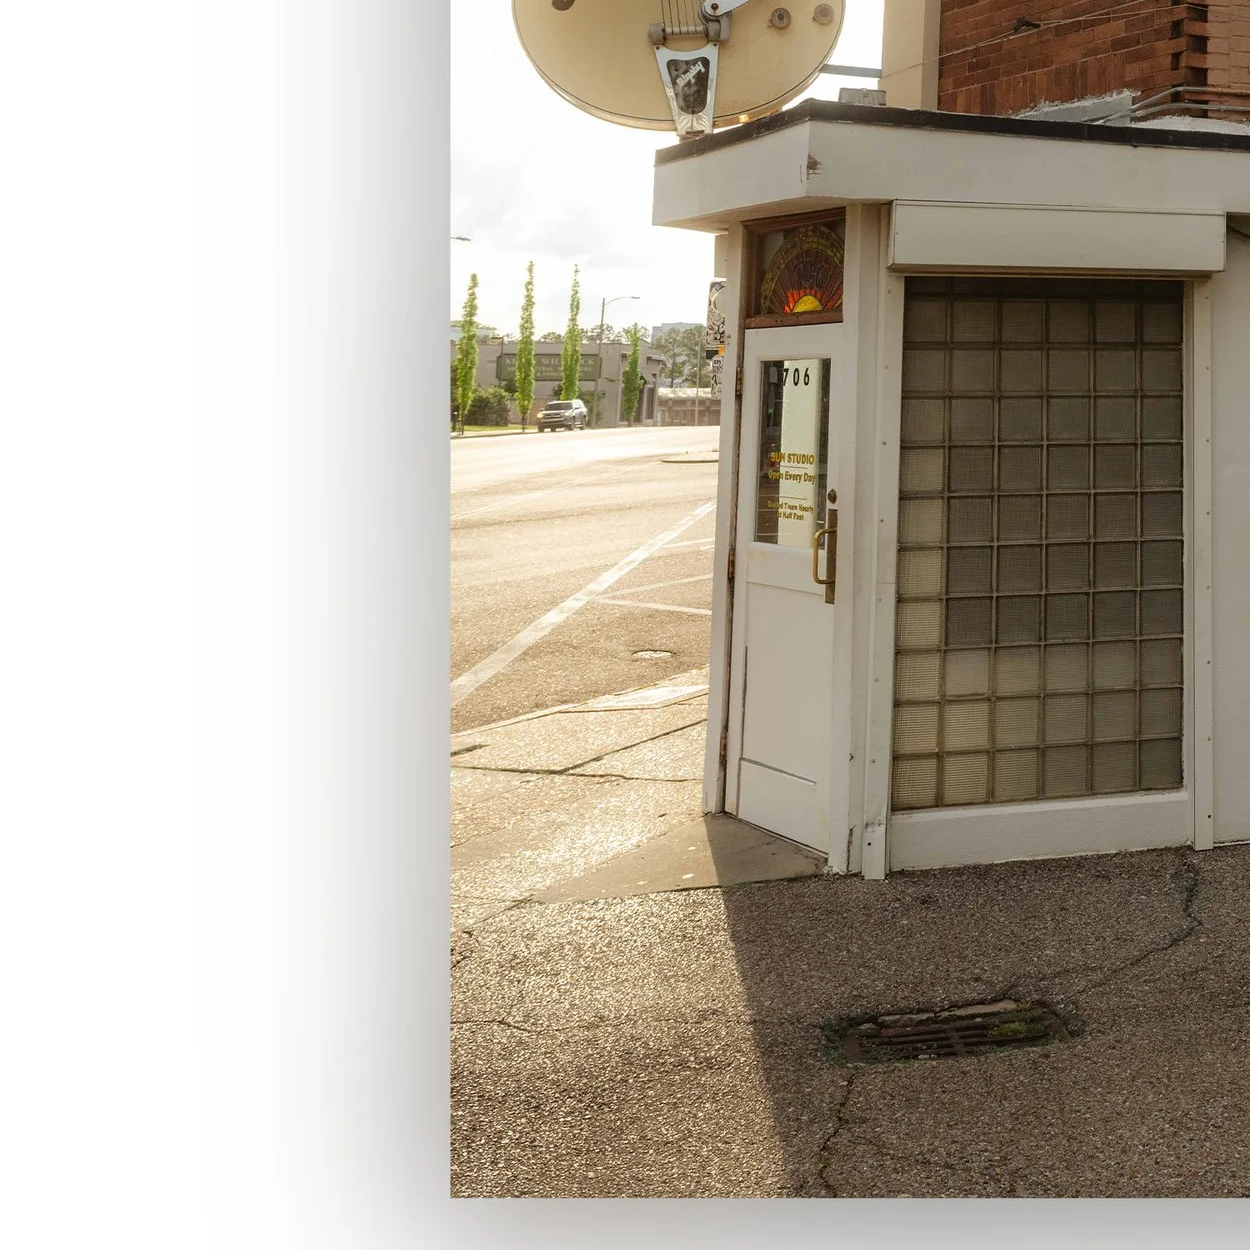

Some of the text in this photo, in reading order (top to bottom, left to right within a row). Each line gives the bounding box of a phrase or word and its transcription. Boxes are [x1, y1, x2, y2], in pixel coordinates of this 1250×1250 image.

[782, 367, 810, 386] 706
[771, 452, 815, 465] SUN STUDIO
[768, 470, 816, 485] Open Every Day
